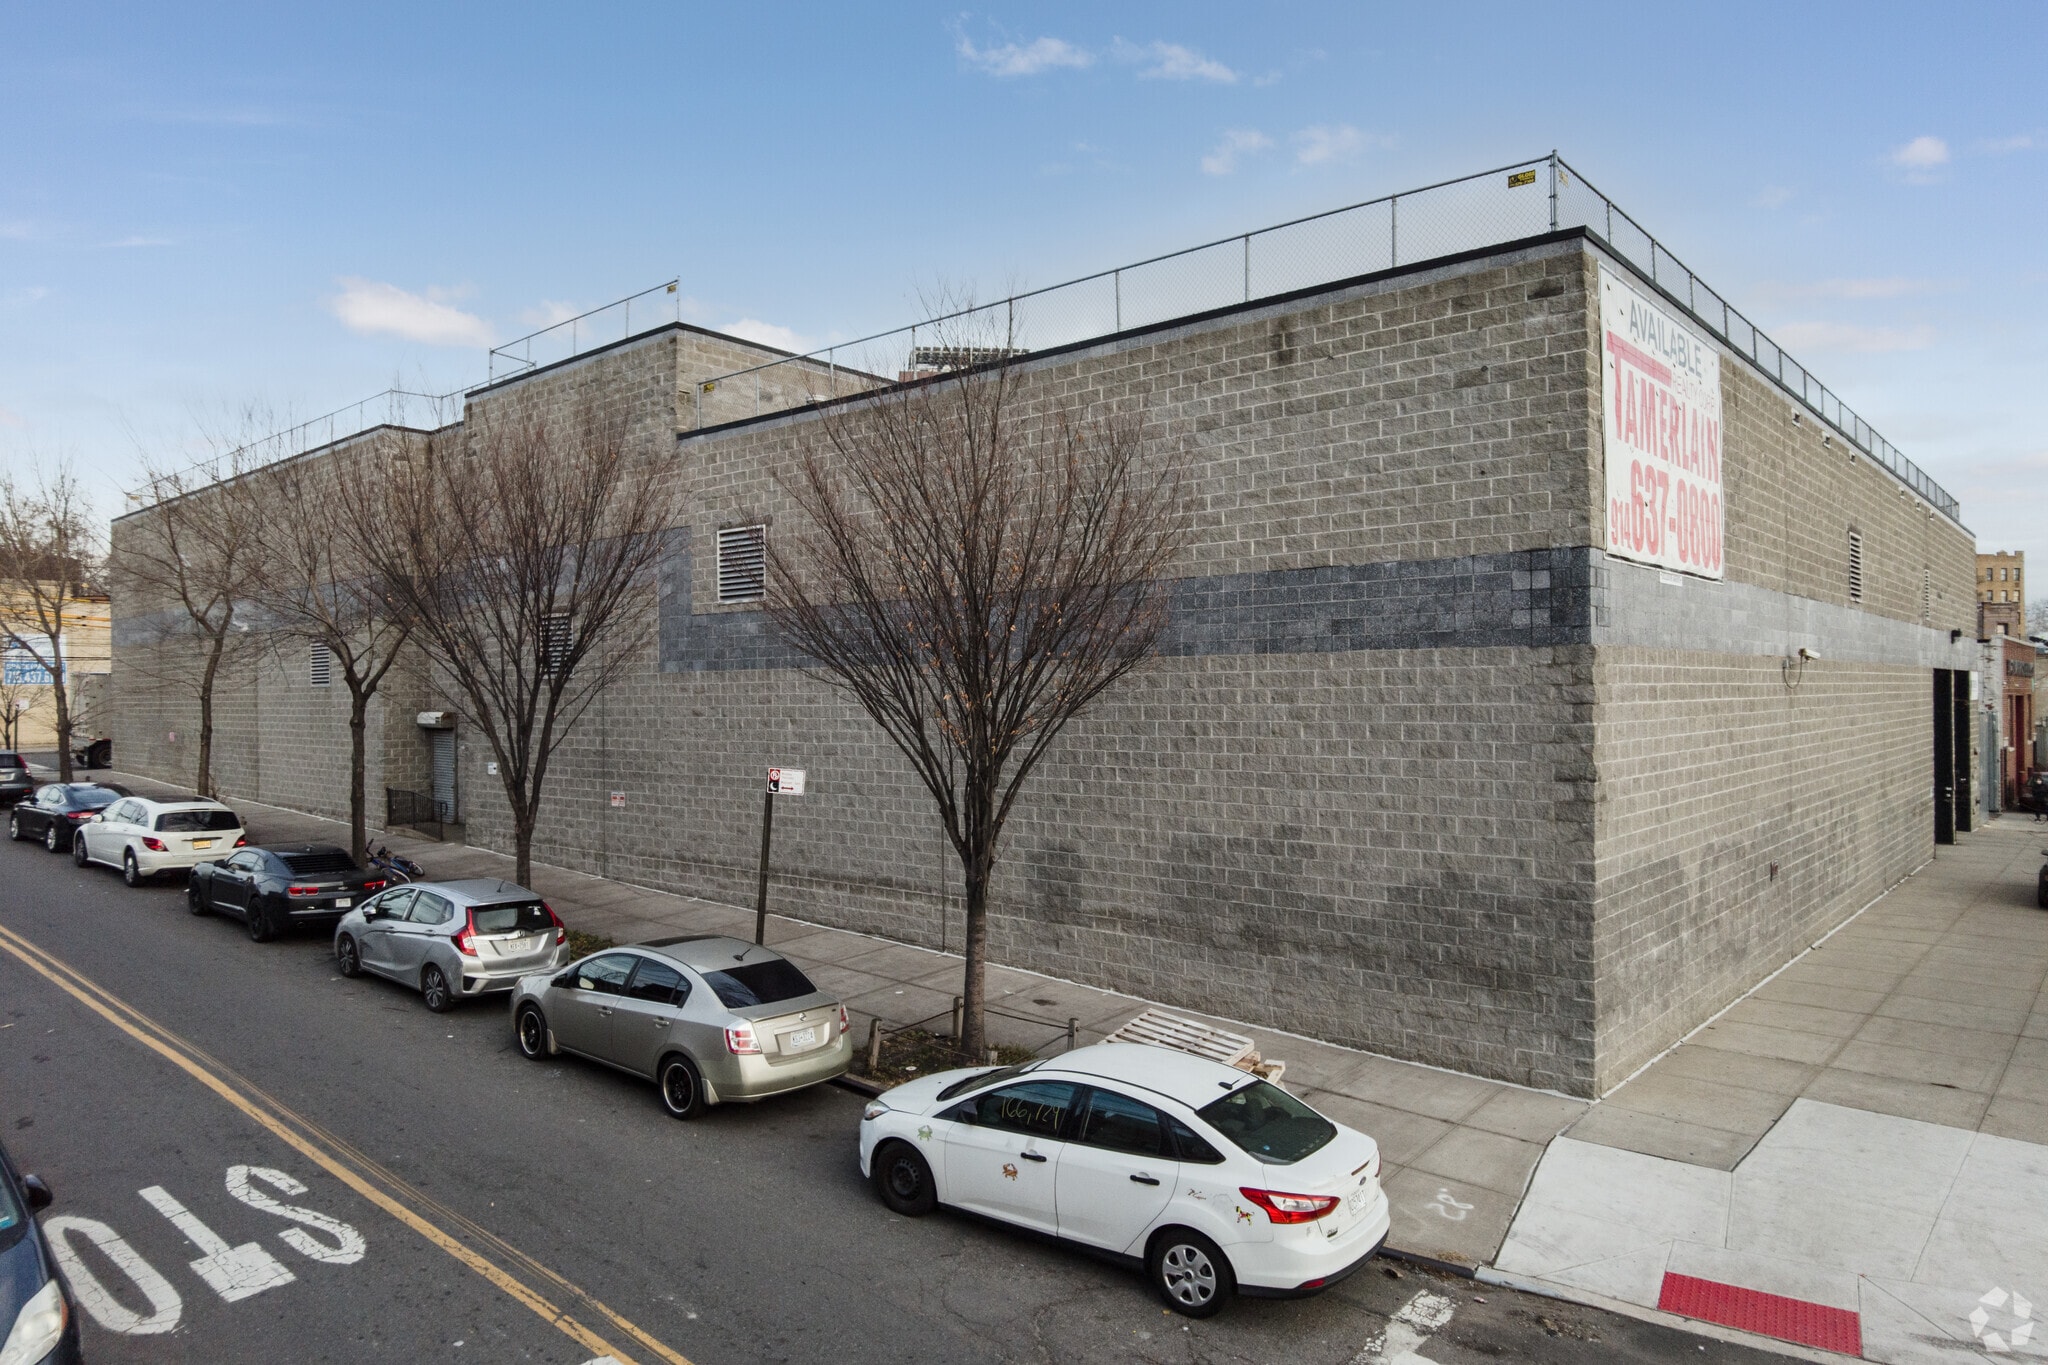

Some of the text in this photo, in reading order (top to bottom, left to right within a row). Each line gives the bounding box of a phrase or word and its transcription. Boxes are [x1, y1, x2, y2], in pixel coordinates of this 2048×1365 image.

[1629, 299, 1703, 379] AVAILABLE
[1606, 329, 1719, 484] TAMERLAIN
[1610, 458, 1721, 572] 914 637-0800
